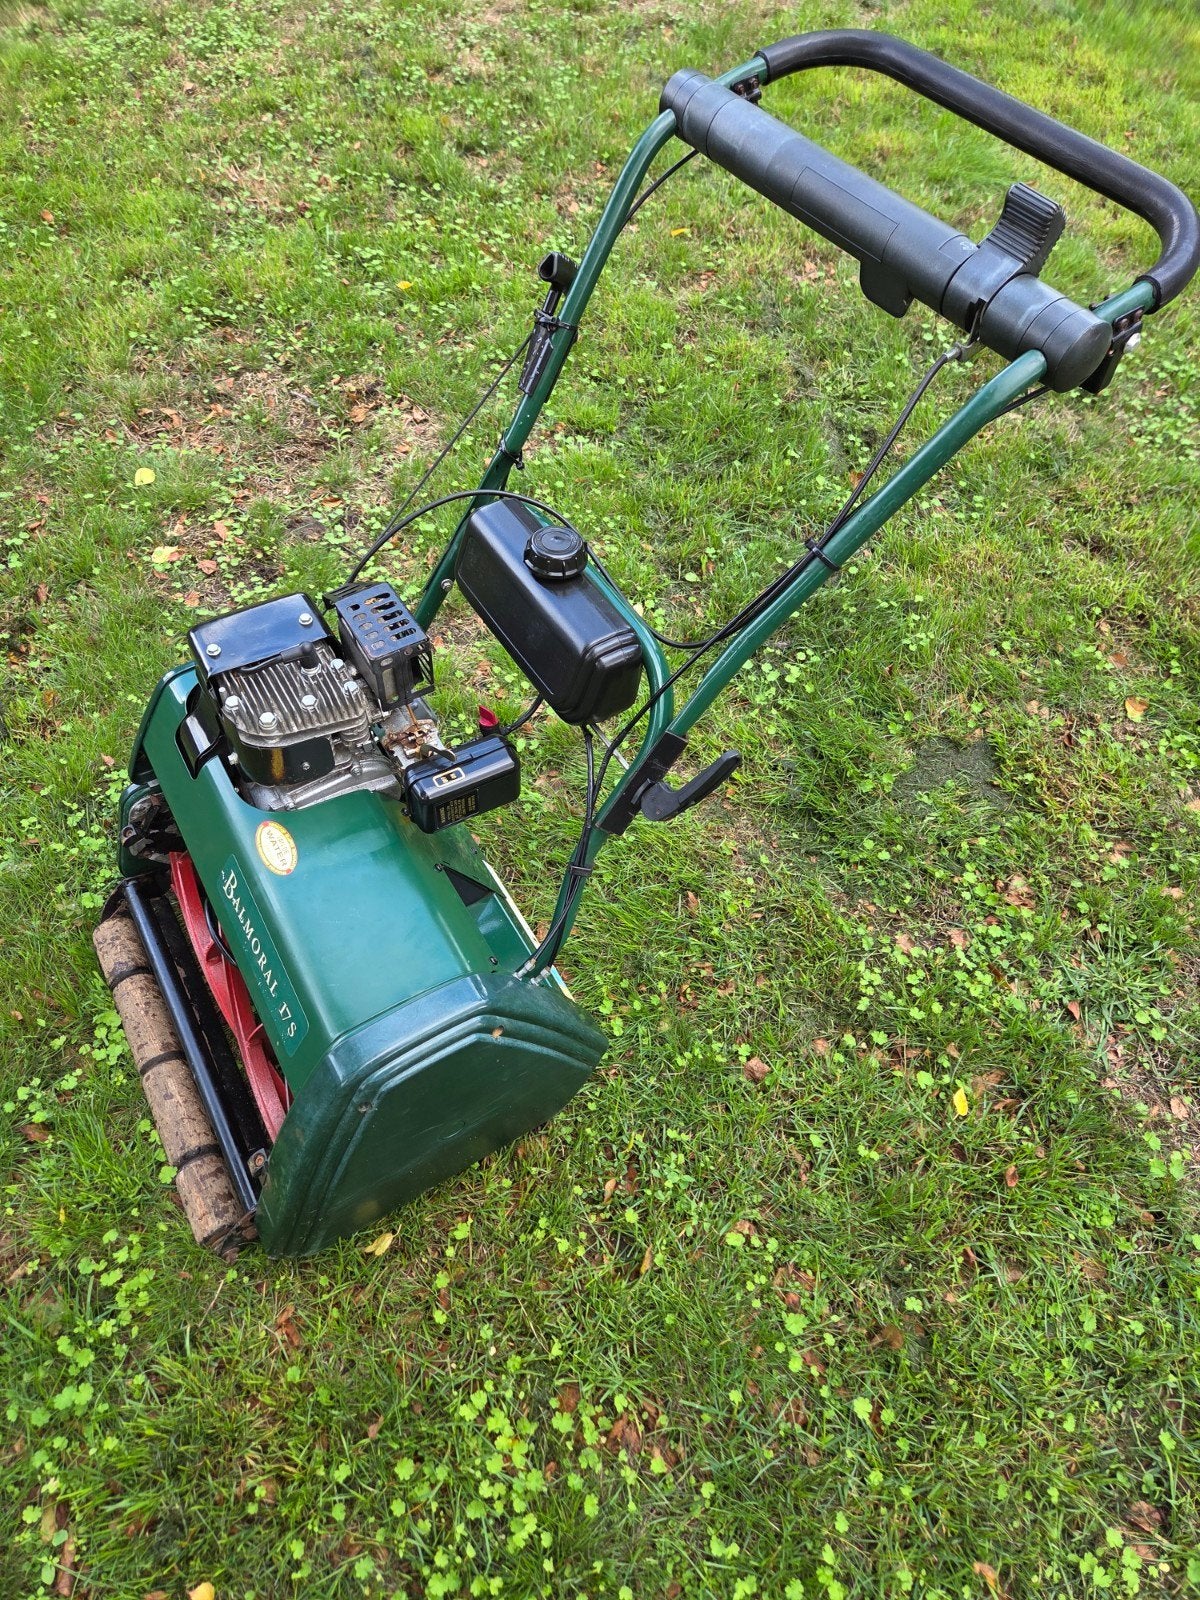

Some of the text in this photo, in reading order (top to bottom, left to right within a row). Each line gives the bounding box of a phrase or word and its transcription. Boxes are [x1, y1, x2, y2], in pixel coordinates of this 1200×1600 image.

[266, 830, 288, 867] WATER
[279, 1002, 292, 1021] 17
[287, 1022, 298, 1038] S
